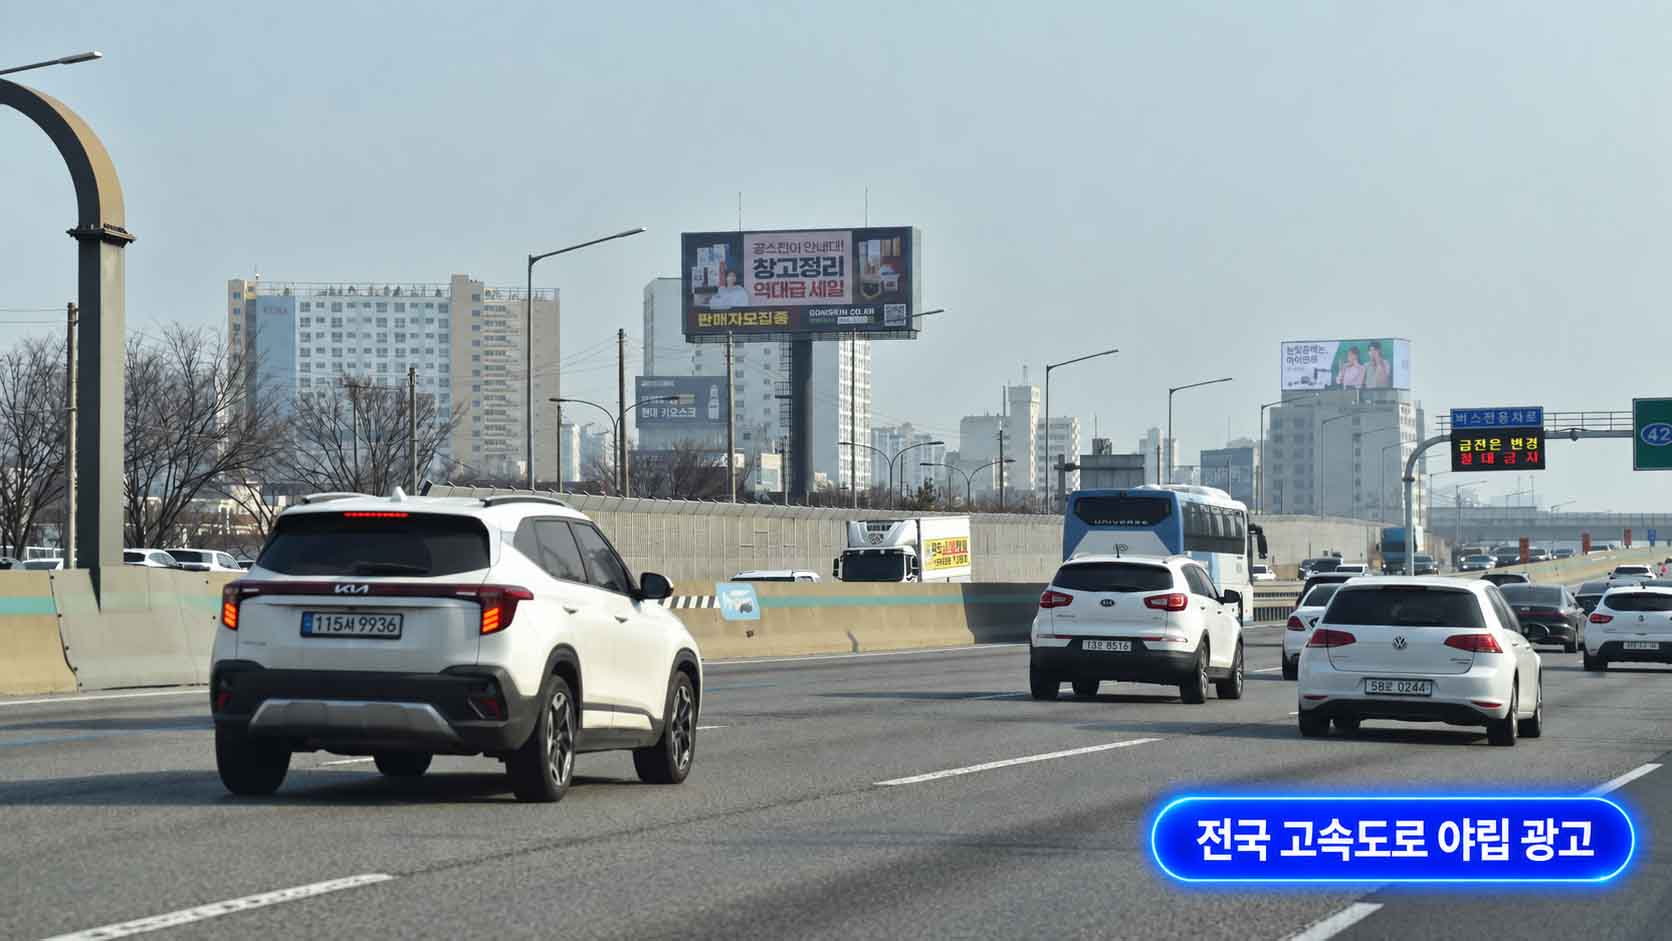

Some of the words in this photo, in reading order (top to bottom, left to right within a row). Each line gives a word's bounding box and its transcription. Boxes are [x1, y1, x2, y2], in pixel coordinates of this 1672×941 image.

[753, 256, 844, 279] 창고정리
[753, 281, 806, 299] 역대급
[809, 280, 845, 298] 세일
[698, 311, 789, 327] 판매자모집중
[661, 407, 697, 418] 키오스크
[1648, 427, 1671, 441] 42
[1510, 436, 1538, 450] 변경
[335, 584, 369, 593] KIA
[315, 616, 355, 632] 115서
[358, 617, 397, 633] 9936
[1397, 682, 1425, 693] 0244
